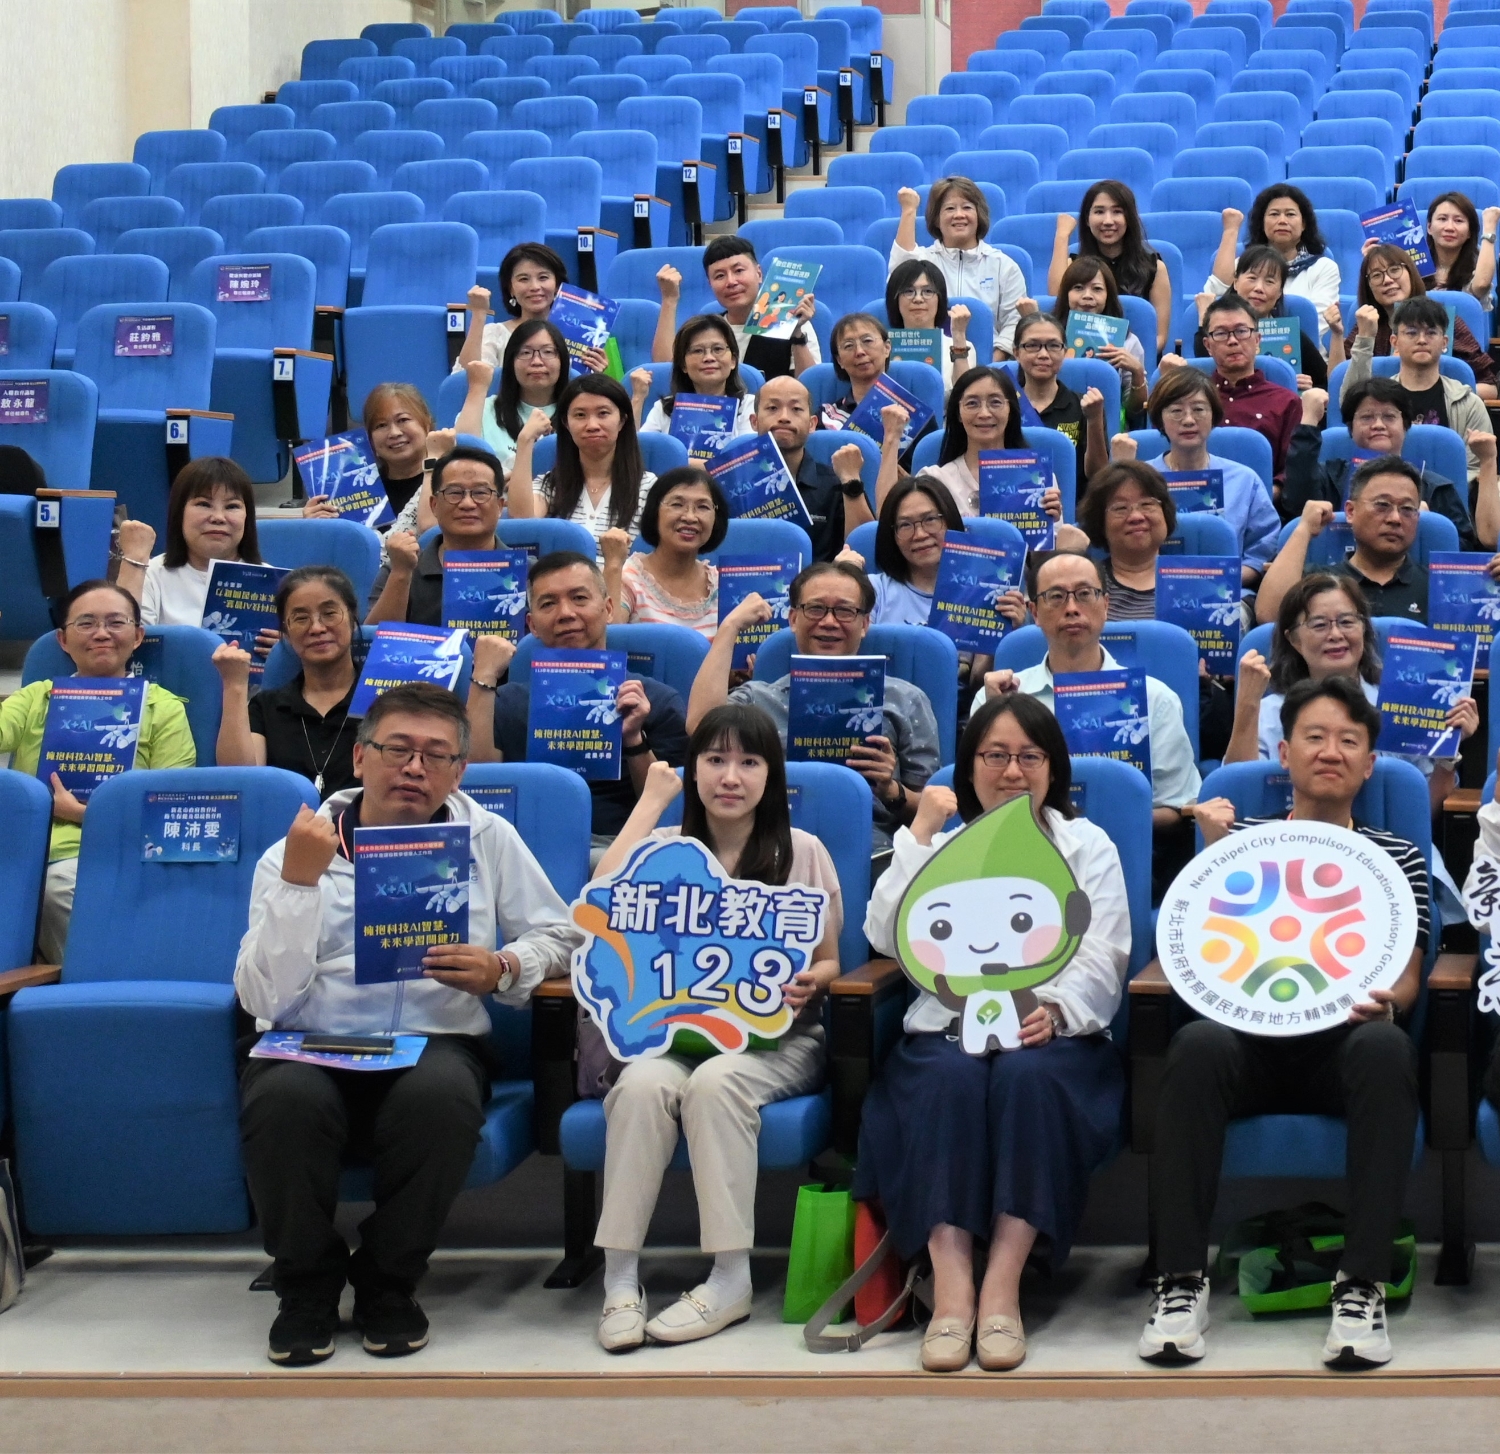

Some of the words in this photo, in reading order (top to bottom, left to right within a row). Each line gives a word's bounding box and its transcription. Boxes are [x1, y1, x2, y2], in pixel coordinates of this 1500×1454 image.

[871, 56, 880, 66] 17
[840, 74, 848, 84] 16
[805, 93, 813, 102] 15
[769, 116, 776, 126] 14
[729, 141, 738, 150] 13
[684, 169, 692, 179] 12
[636, 204, 645, 213] 11
[579, 237, 589, 247] 10
[450, 314, 456, 327] 8
[278, 361, 285, 375] 7
[170, 423, 179, 438] 6
[40, 504, 50, 522] 5
[936, 601, 998, 620] 擁抱科技AI智慧-
[947, 614, 1005, 631] 未來學習關鍵力
[545, 694, 576, 706] X+AI
[805, 702, 840, 715] X+AI
[1381, 702, 1447, 718] 擁抱科技AI智慧-
[60, 718, 92, 731] X+AI
[533, 729, 604, 739] 擁抱科技AI智慧-
[547, 741, 613, 751] 未來學習關鍵力
[46, 751, 116, 762] 擁抱科技AI智慧-
[58, 763, 124, 773] 未來學習關鍵力
[163, 821, 220, 839] 陳沛雯
[181, 842, 201, 852] 科長
[1251, 835, 1277, 849] City
[1279, 833, 1357, 857] Compulsory
[1211, 842, 1249, 869] Taipei
[1189, 867, 1213, 890] New
[1355, 851, 1395, 901] Education
[375, 882, 414, 897] X+AI
[608, 882, 825, 942] 新北教育
[364, 920, 448, 937] 擁抱科技AI智慧-
[1384, 902, 1403, 952] Advisory
[380, 932, 460, 949] 未來學習關鍵力
[1359, 952, 1393, 990] Groups
